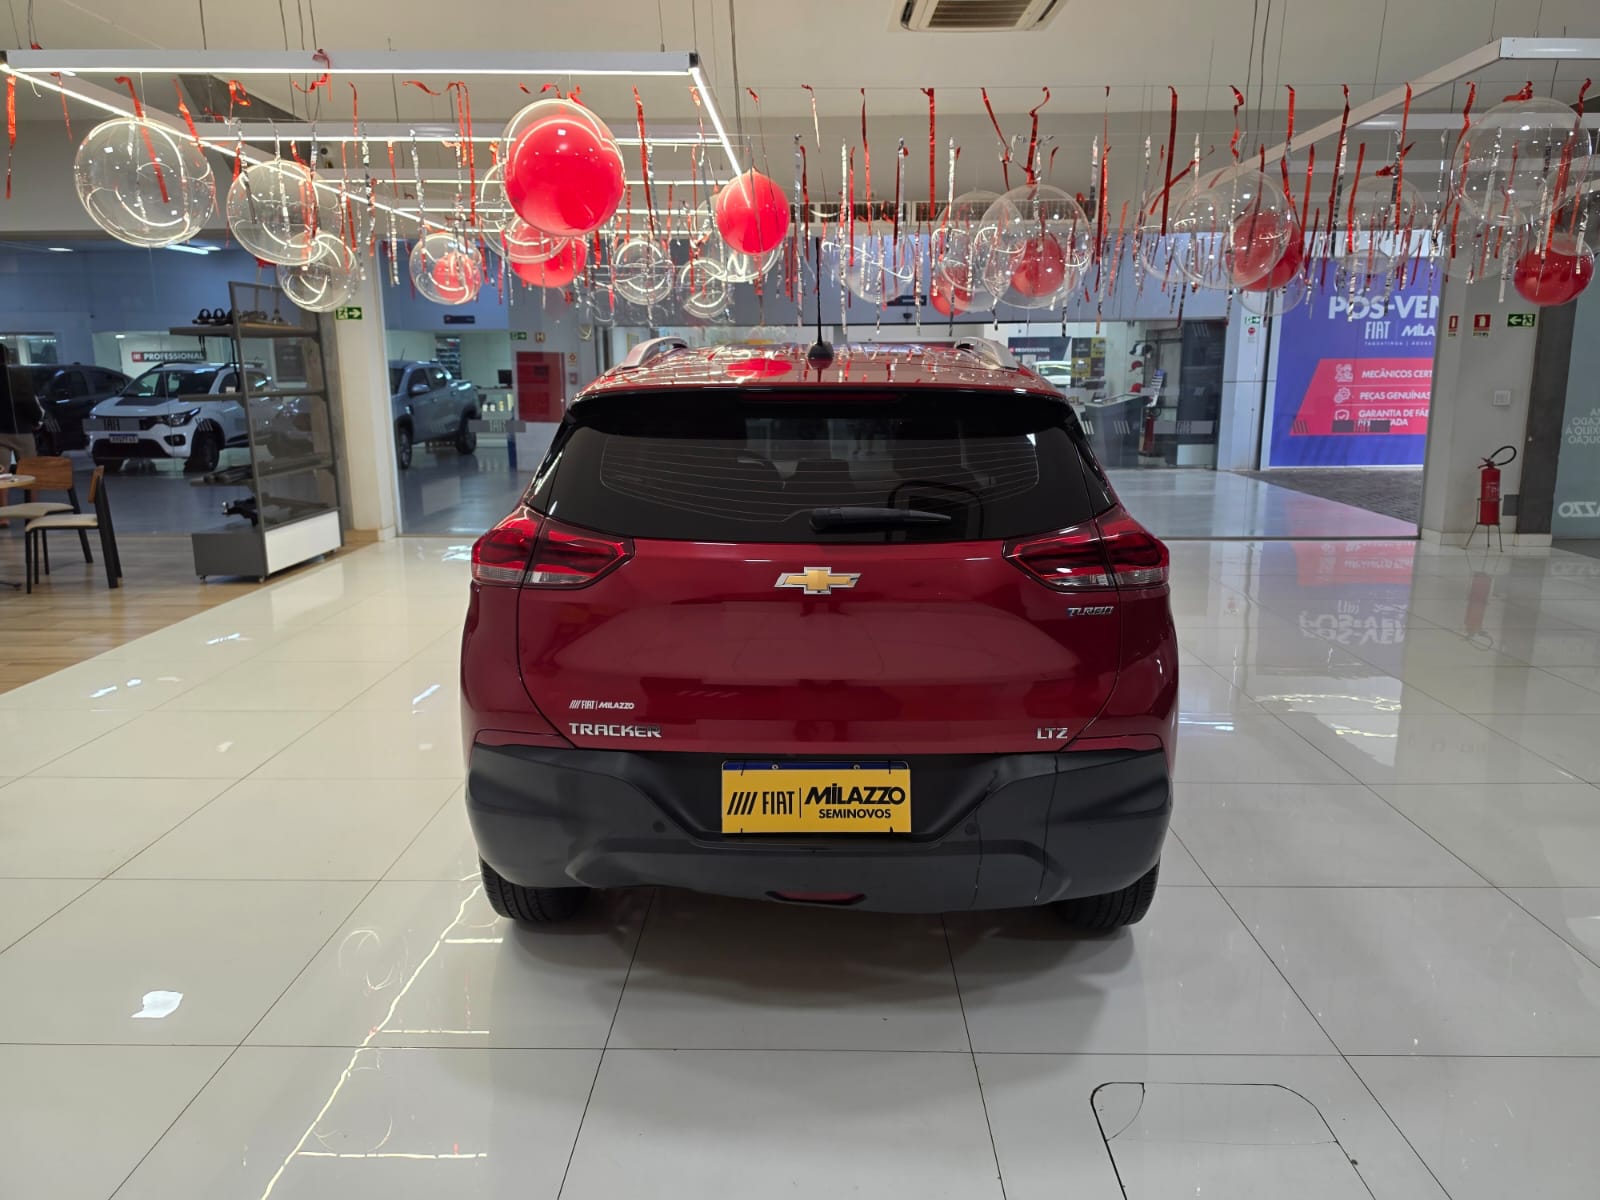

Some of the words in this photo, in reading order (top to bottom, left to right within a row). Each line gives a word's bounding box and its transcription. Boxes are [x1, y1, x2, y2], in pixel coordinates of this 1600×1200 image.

[1365, 321, 1391, 339] FIAT
[143, 352, 205, 361] PROFESSIONAL
[1361, 368, 1412, 378] MECÂNICOS
[1359, 392, 1386, 402] PEÇAS
[1358, 409, 1401, 418] GARANTIA
[1403, 409, 1414, 417] DE
[1067, 606, 1114, 617] TURBO
[581, 700, 595, 710] FIAT
[568, 722, 662, 738] TRACKER
[1036, 727, 1068, 740] LTZ
[762, 791, 795, 815] FIAT
[818, 808, 892, 820] SEMINOVOS
